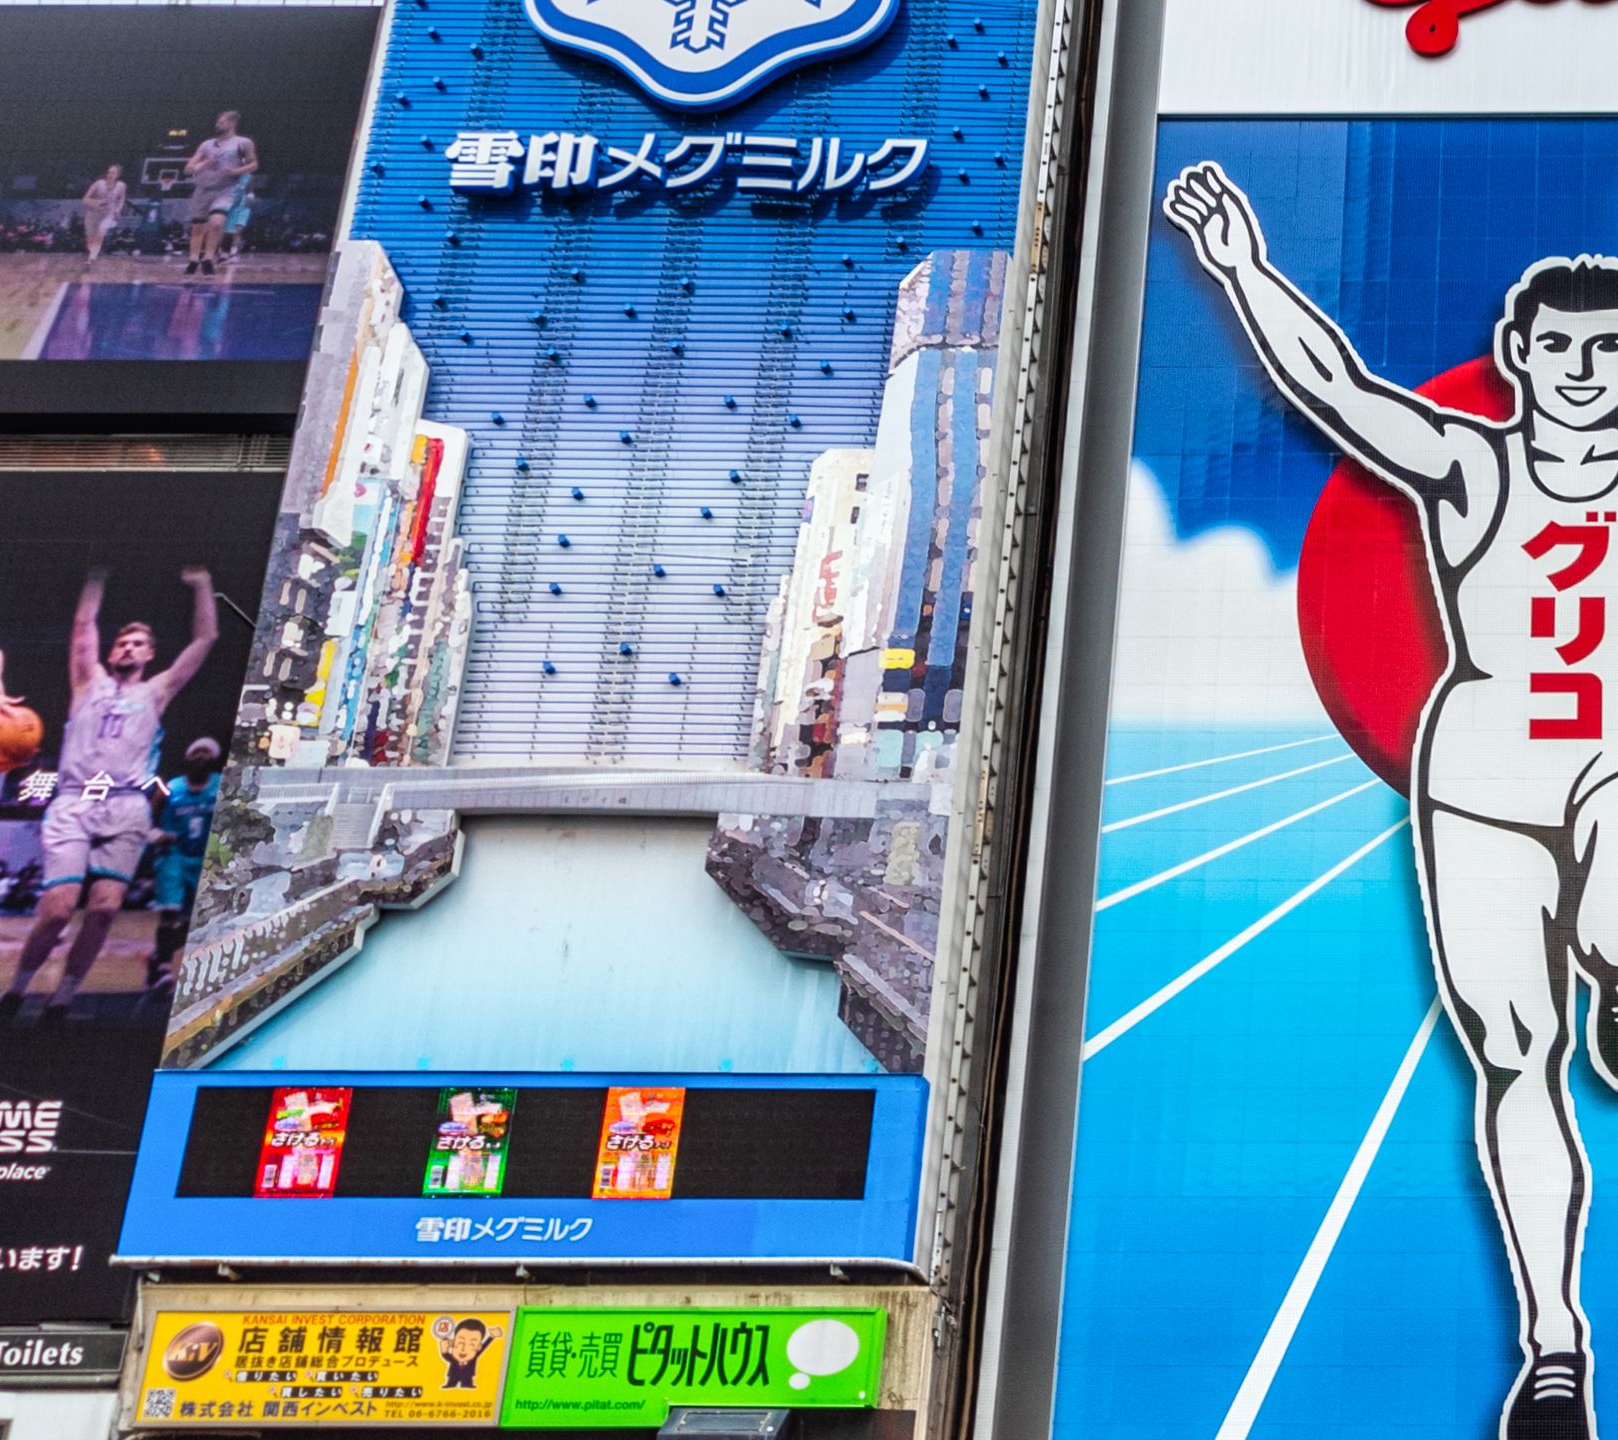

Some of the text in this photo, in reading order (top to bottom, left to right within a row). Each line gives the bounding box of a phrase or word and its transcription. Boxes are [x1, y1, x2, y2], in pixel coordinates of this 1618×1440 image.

[445, 129, 930, 194] 雪印メグミルク
[1523, 511, 1618, 740] グリコ
[415, 1216, 594, 1243] 雪印メグミルク
[243, 1314, 426, 1325] KANSAI INVEST CORPORATION
[238, 1326, 424, 1354] 店舗情報館
[627, 1322, 770, 1386] ピタットハウス
[180, 1401, 378, 1417] 株式会社 関西インベスト
[384, 1410, 404, 1419] TEL
[515, 1399, 646, 1411] http://www.pitat.com/
